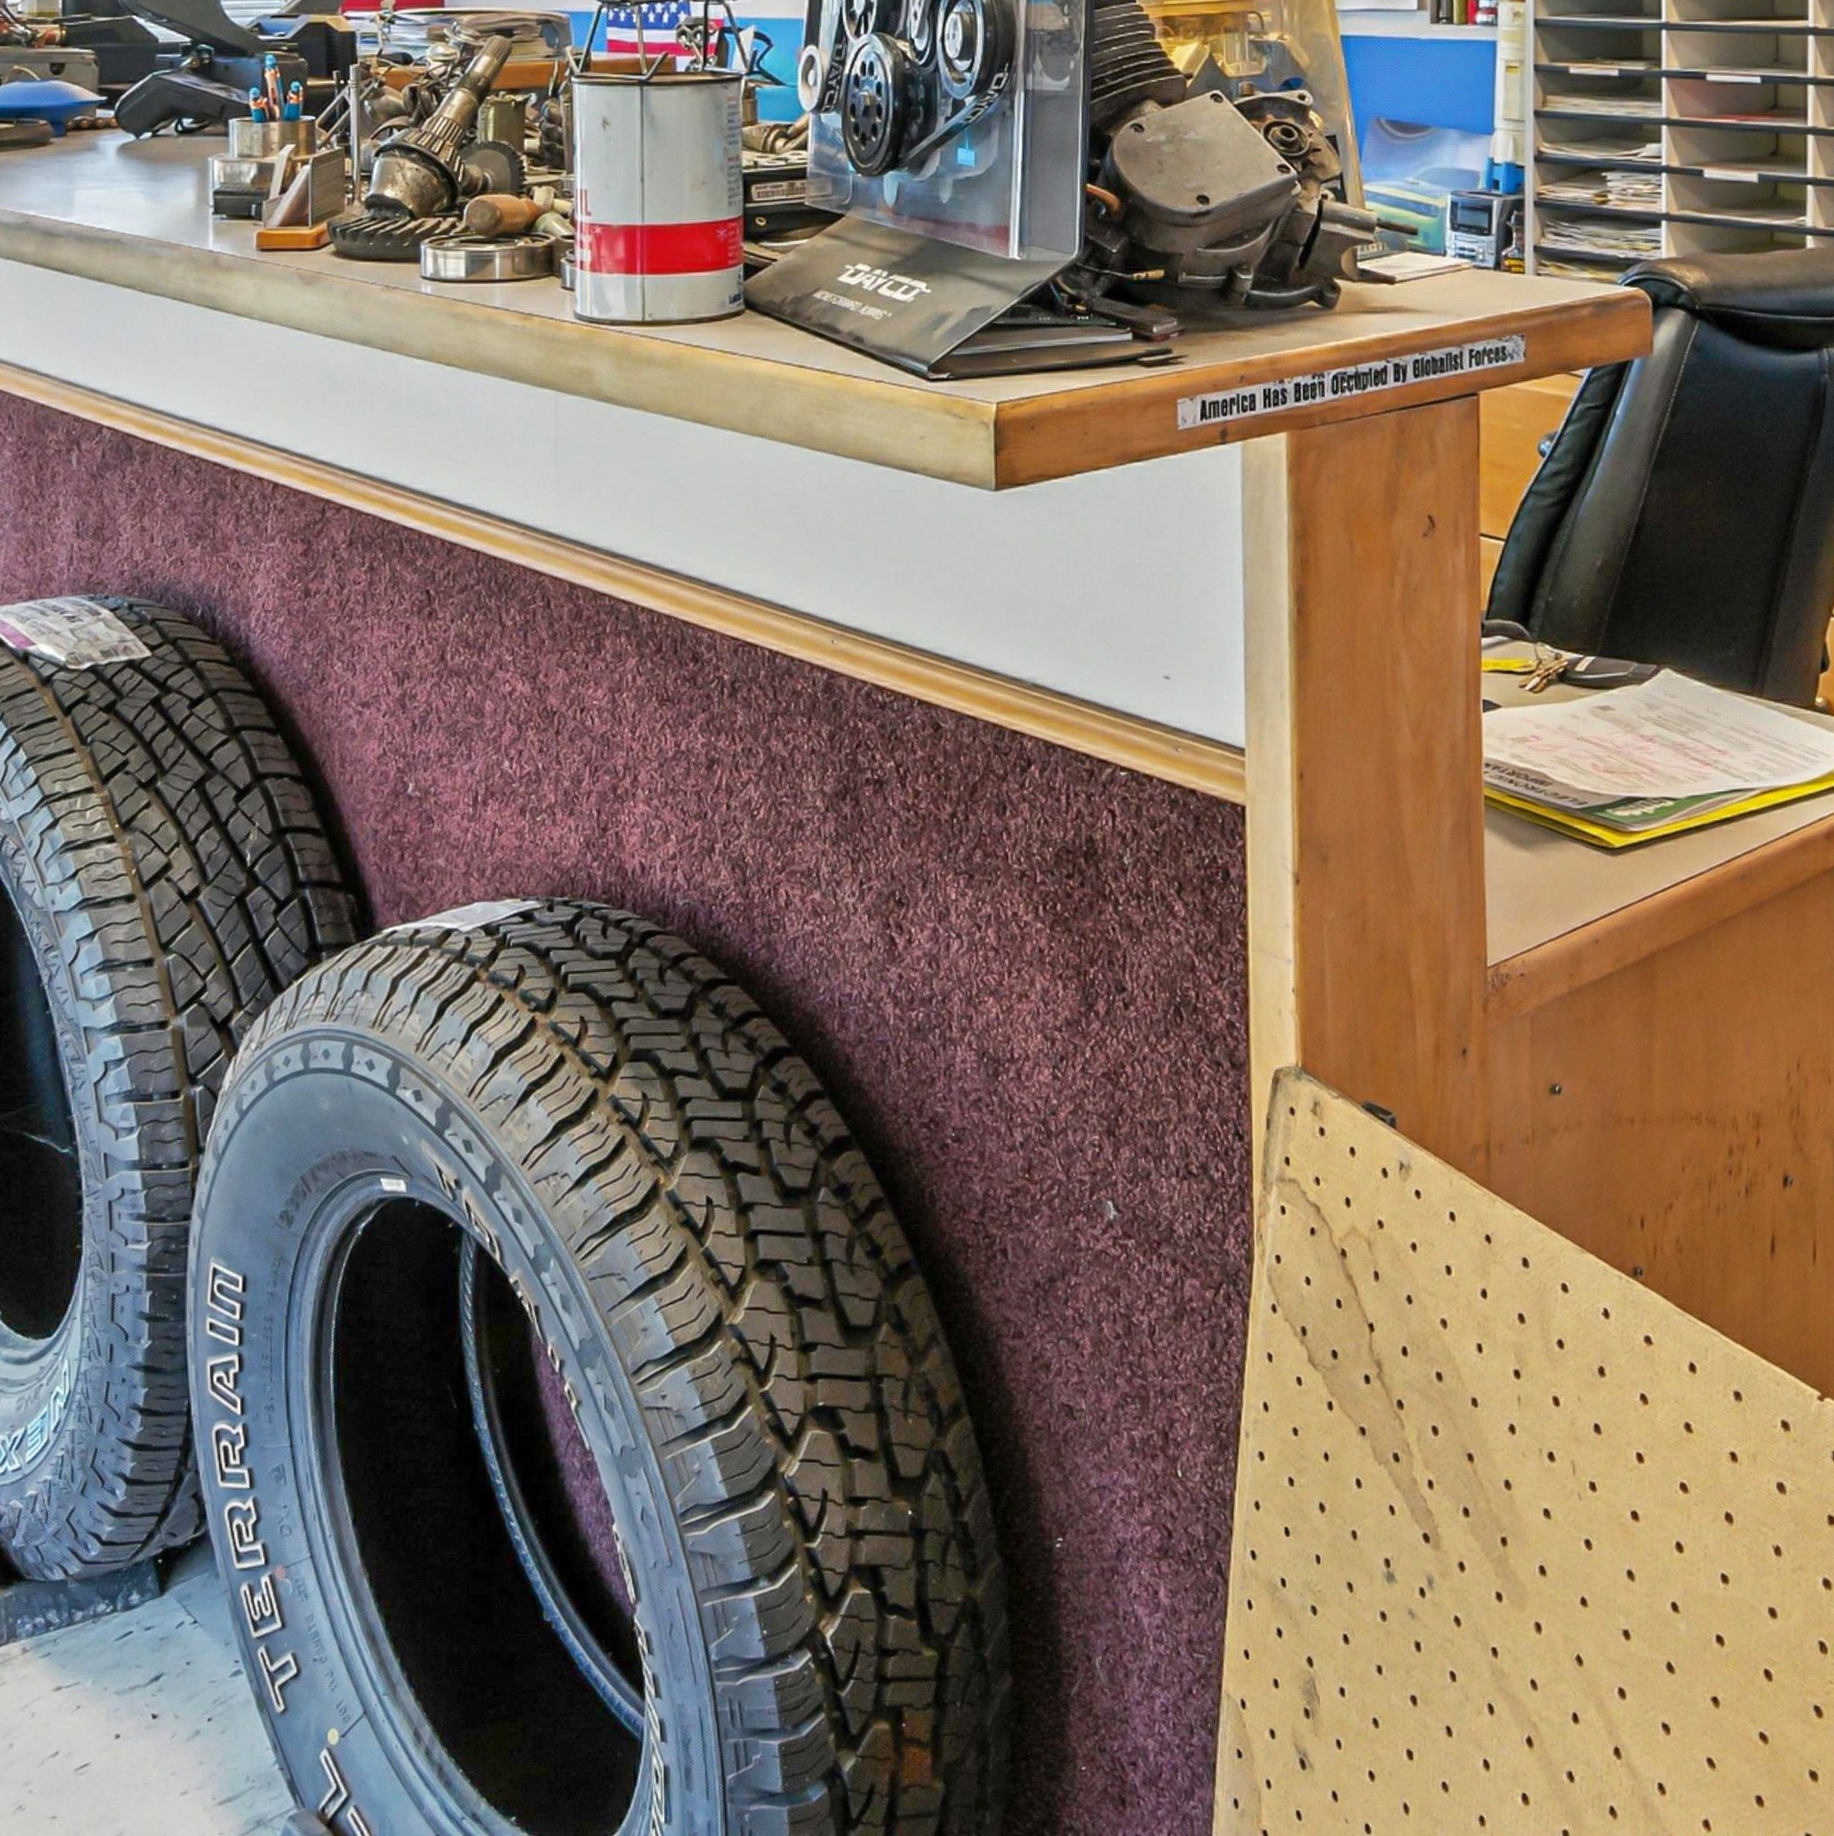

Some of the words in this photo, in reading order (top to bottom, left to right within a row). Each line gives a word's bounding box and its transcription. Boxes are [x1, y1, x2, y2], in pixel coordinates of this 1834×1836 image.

[836, 262, 932, 303] DAYCO
[1200, 392, 1257, 421] America
[1263, 387, 1288, 409] Has
[1294, 377, 1326, 403] Been
[1331, 365, 1388, 395] Occupied
[1393, 362, 1407, 383] By
[1412, 351, 1465, 378] Globalist
[206, 1257, 303, 1714] TERRAIN
